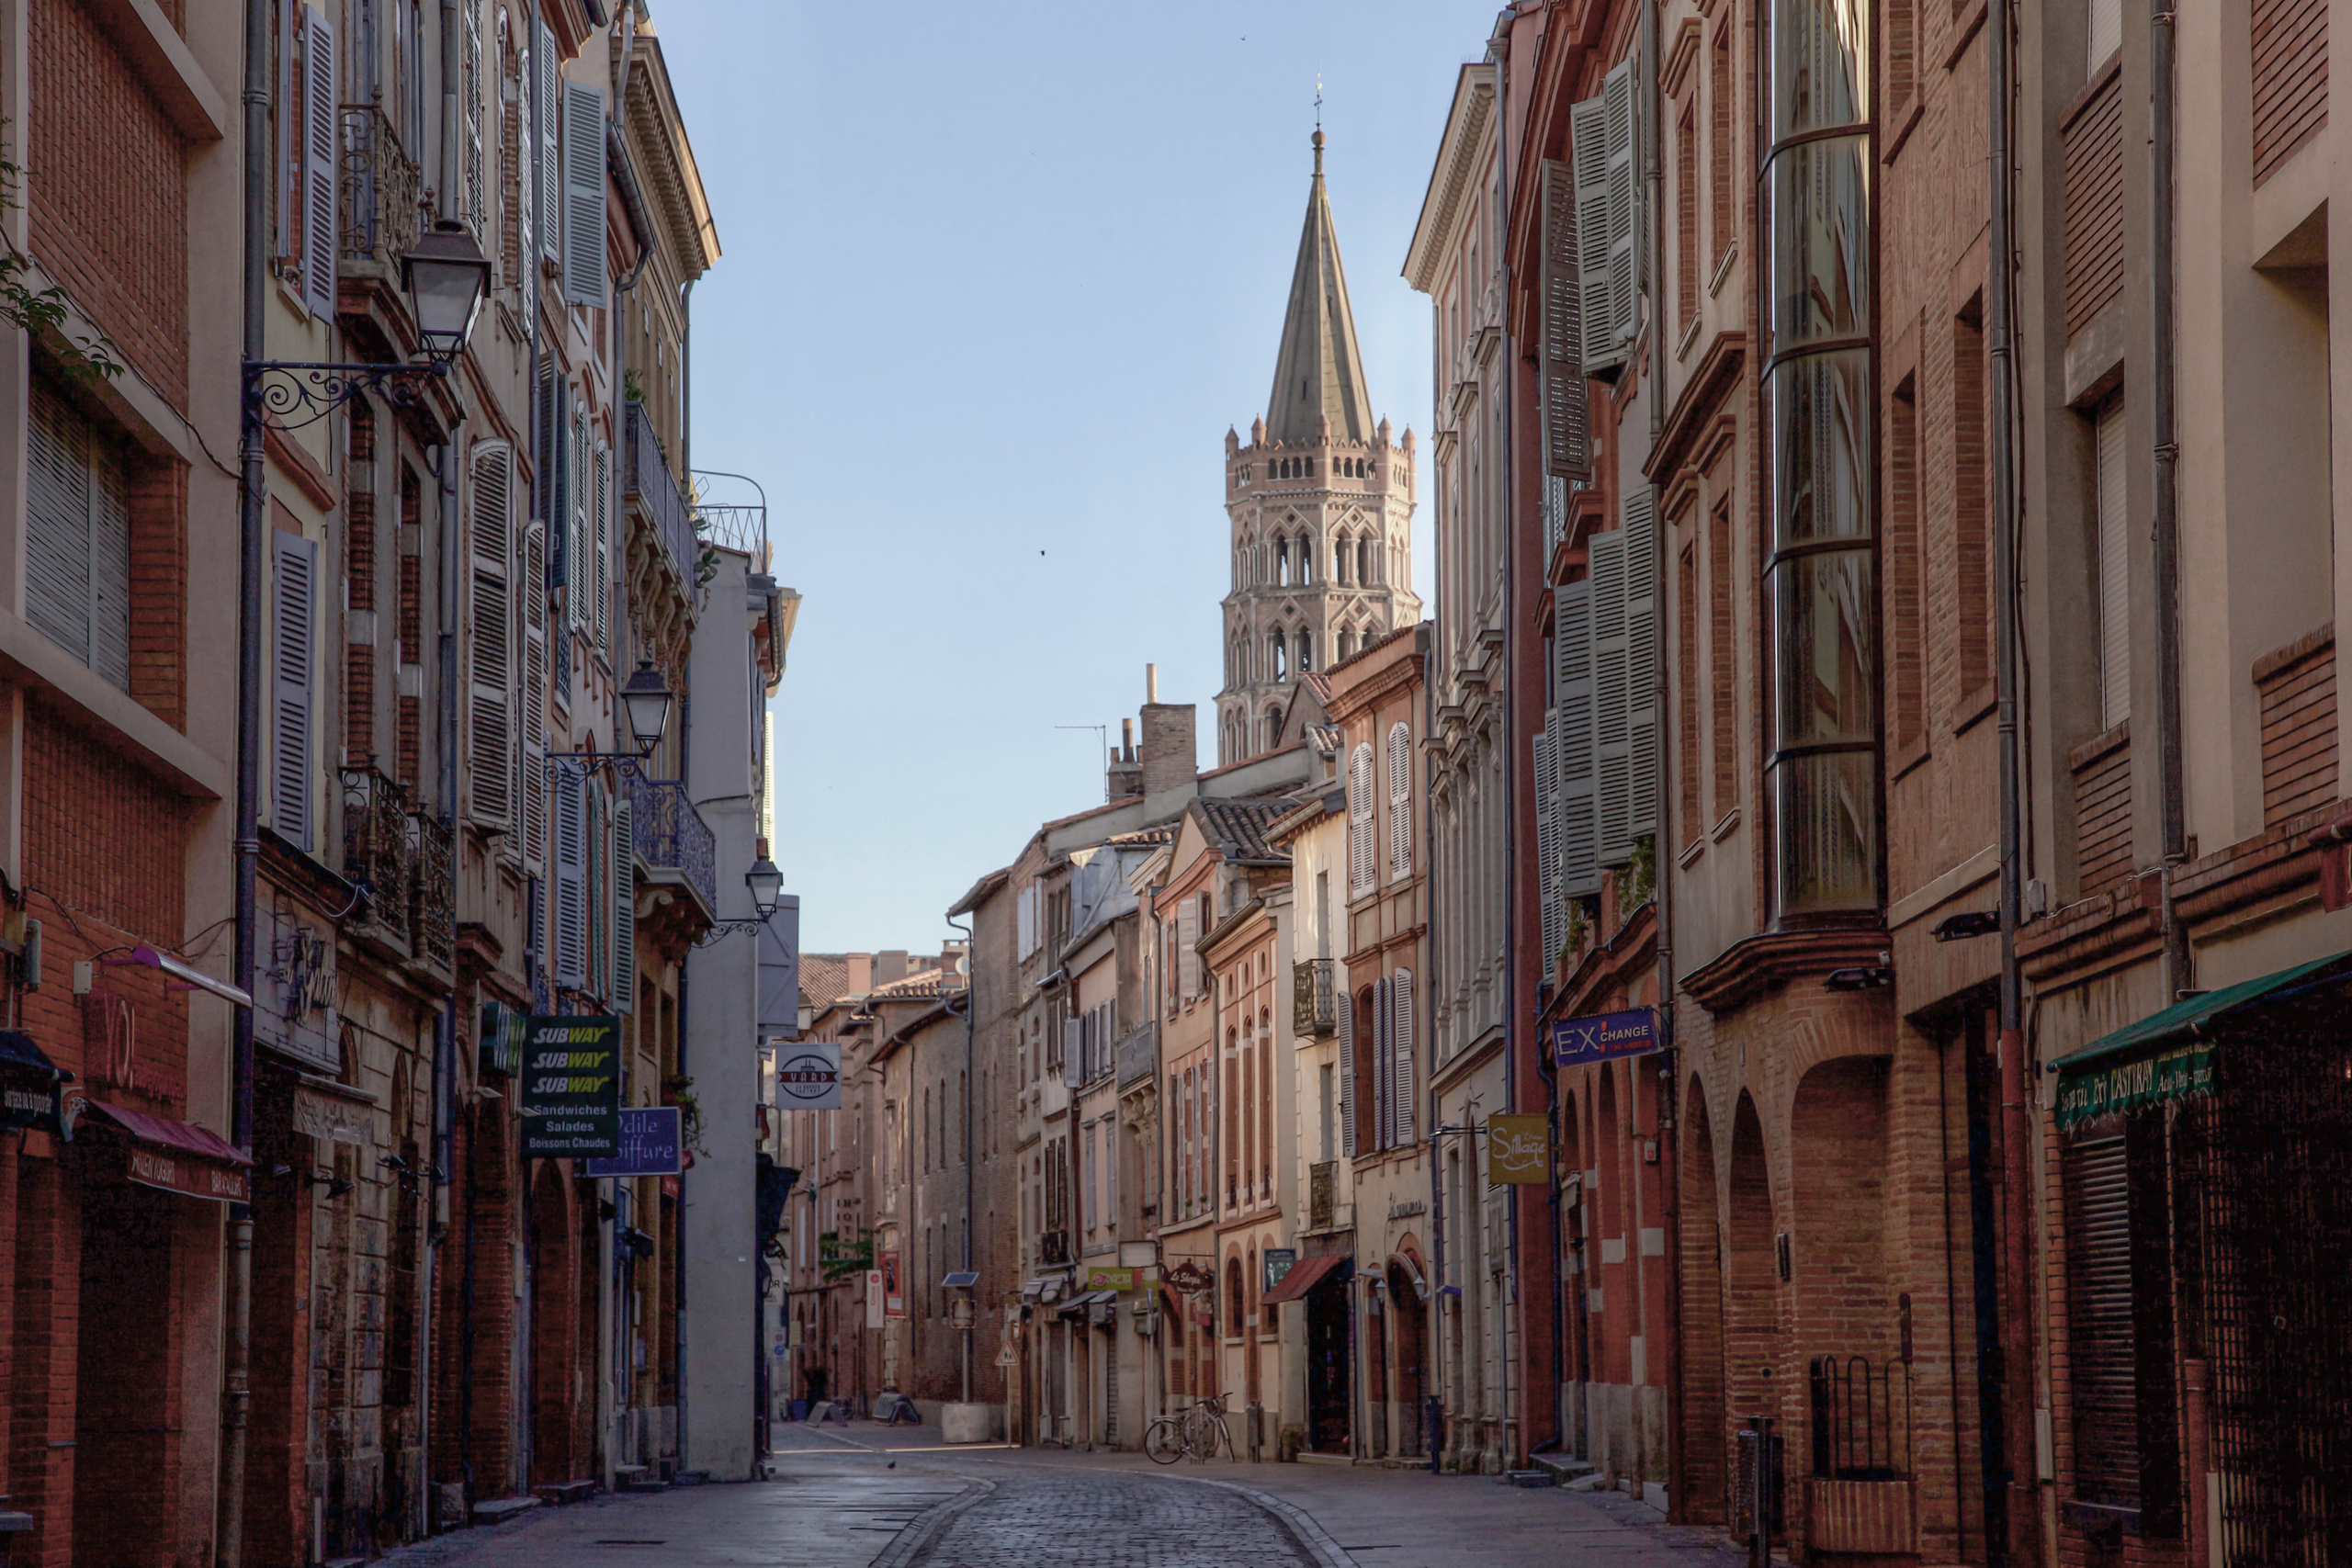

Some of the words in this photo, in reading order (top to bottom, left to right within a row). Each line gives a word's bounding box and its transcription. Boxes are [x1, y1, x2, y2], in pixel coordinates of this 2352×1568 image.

[532, 1026, 611, 1044] SUBWAY
[1600, 1025, 1649, 1043] CHANGE
[531, 1051, 610, 1069] SUBWAY
[531, 1076, 610, 1093] SUBWAY
[533, 1104, 607, 1116] Sandwiches
[546, 1121, 594, 1132] Salades
[529, 1137, 570, 1148] Boissons
[571, 1137, 611, 1148] Chaudes
[599, 1134, 673, 1169] oiffure
[1491, 1126, 1546, 1171] Sillage
